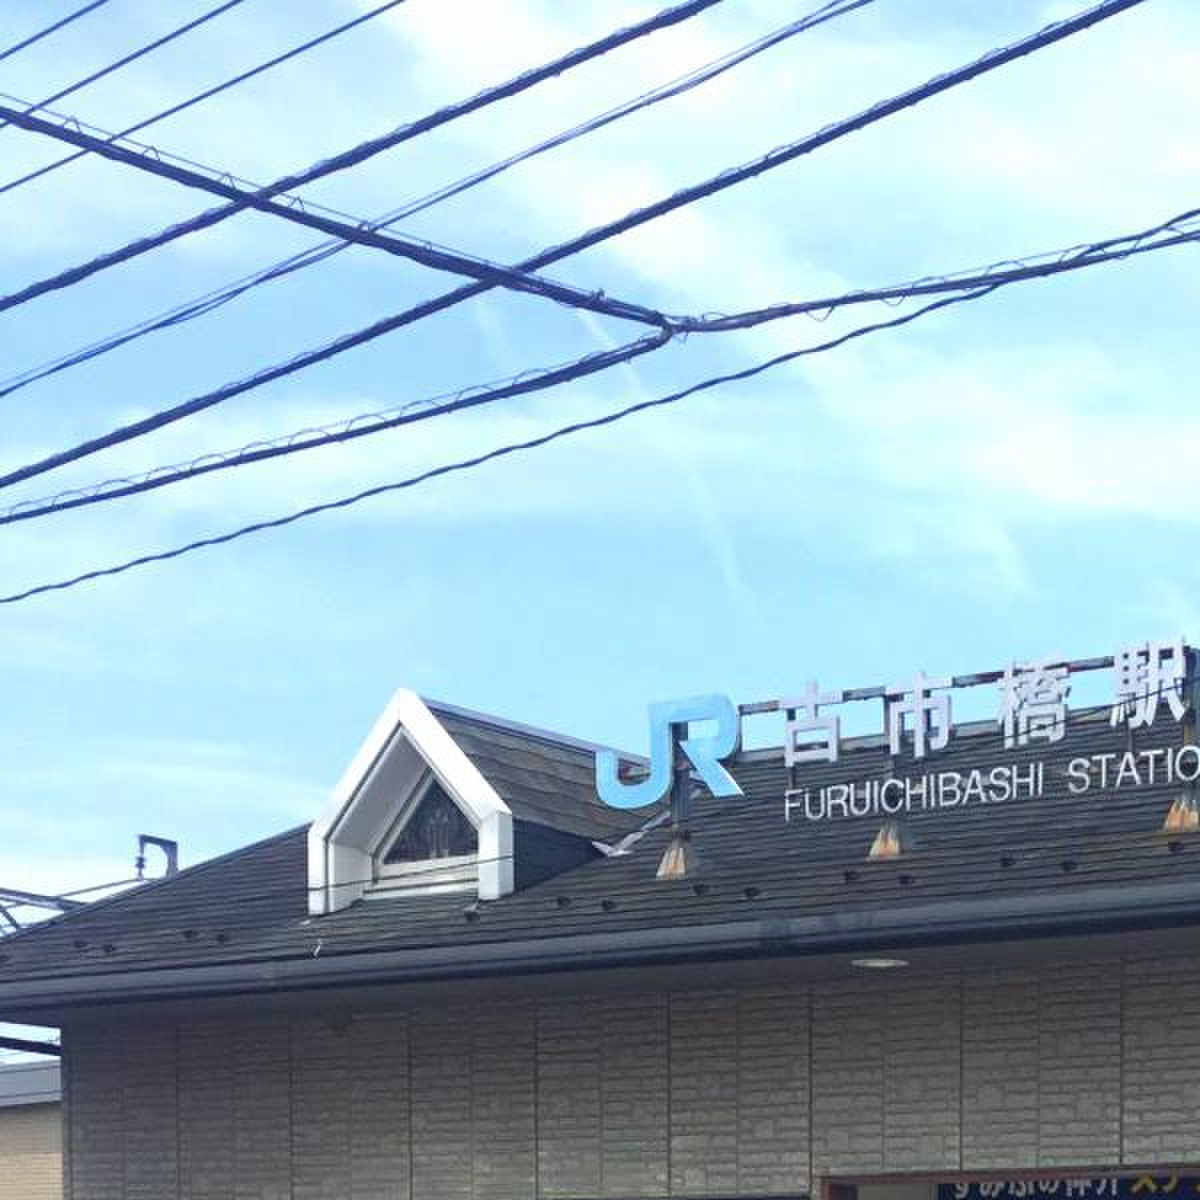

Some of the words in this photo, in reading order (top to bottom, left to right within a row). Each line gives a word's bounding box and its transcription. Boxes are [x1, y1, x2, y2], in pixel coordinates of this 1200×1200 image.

[595, 692, 743, 809] JR
[779, 636, 1187, 768] 古市橋駅
[784, 762, 1044, 823] FURUICHIBASHI
